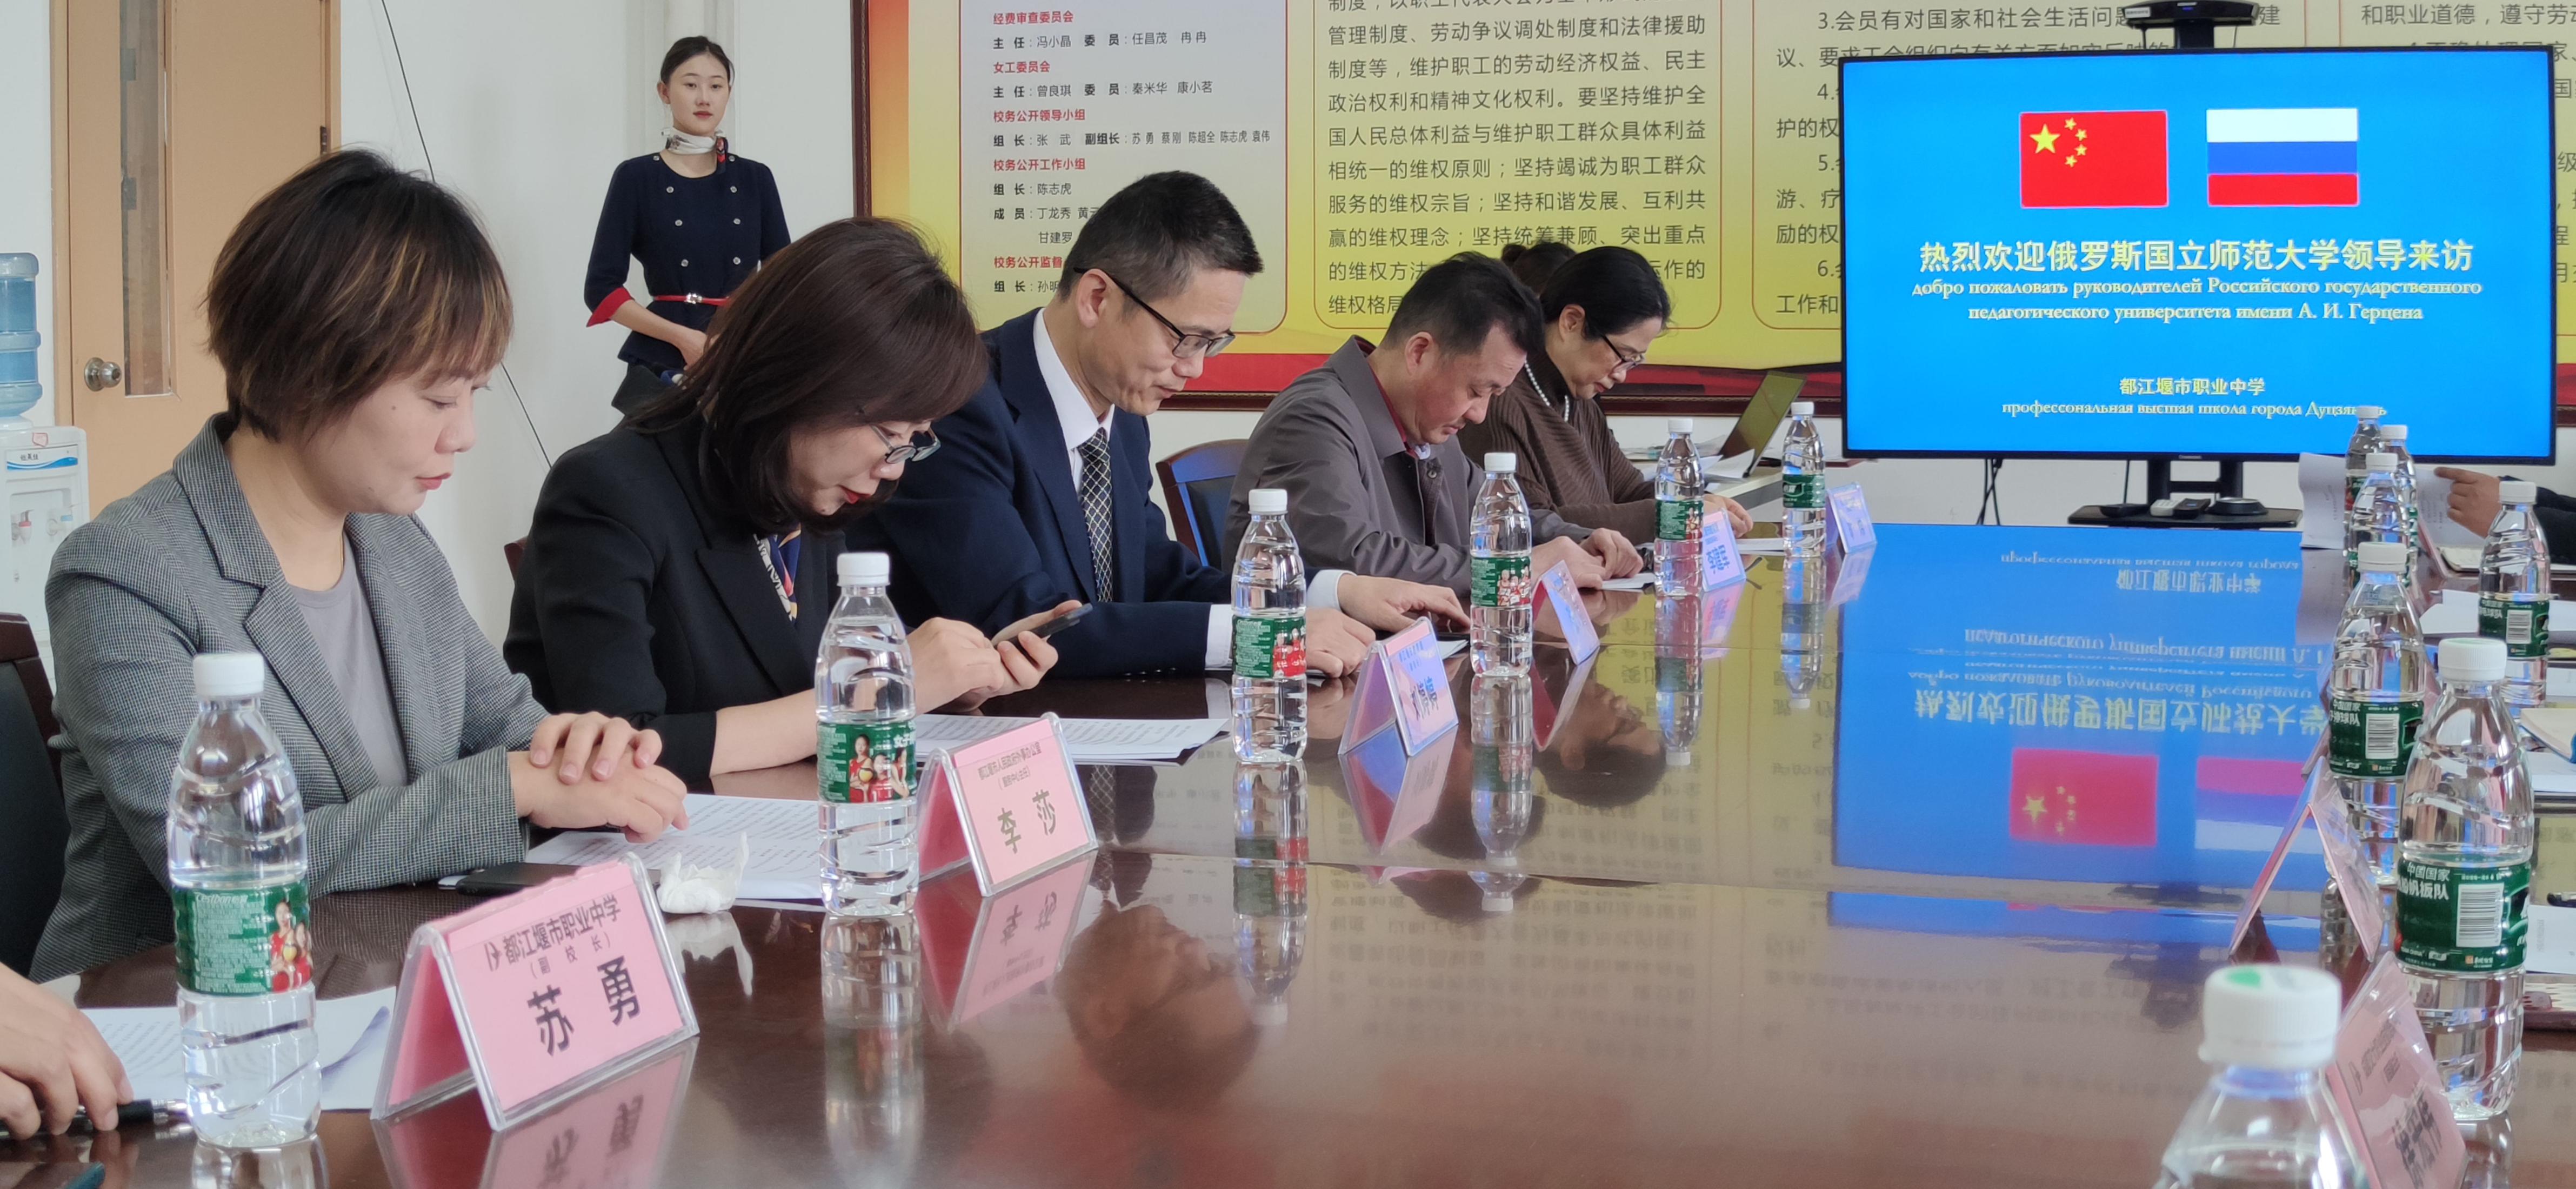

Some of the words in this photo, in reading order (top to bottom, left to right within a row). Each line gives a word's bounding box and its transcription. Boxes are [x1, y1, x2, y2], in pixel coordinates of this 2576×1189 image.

[993, 10, 1073, 24] 经费审查委员会
[2361, 4, 2576, 25] 和职业道德，遵守劳
[1329, 14, 1705, 45] 管理制度、劳动争议调处制度和法律援助
[993, 61, 1050, 74] 女工委员会
[1329, 50, 1706, 79] 制度等，维护职工的劳动经济权益、民主
[1328, 84, 1706, 113] 政治权利和精神文化权利。要坚持维护全
[993, 109, 1085, 122] 校务公开领导小组
[1329, 119, 1706, 147] 国人民总体利益与维护职工群众具体利益
[993, 158, 1086, 171] 校务公开工作小组
[1329, 155, 1706, 181] 相统一的维权原则；坚持竭诚为职工群众
[1329, 190, 1706, 214] 服务的维权宗旨；坚持和谐发展、互利共
[1038, 231, 1072, 244] 甘建罗
[994, 256, 1063, 268] 校务公开监督
[1919, 239, 2474, 272] 热烈欢迎俄罗斯国立师范大学领导来访
[1912, 279, 1964, 299] добро
[1968, 283, 2068, 294] пожаловать
[2073, 277, 2203, 298] руководителей
[2207, 277, 2320, 294] Российского
[2324, 281, 2482, 298] государственного
[1776, 294, 1838, 314] 工作和
[1968, 307, 2109, 320] педагогического
[2114, 307, 2231, 324] университета
[2235, 306, 2292, 318] имени
[2349, 303, 2424, 324] Герцена
[2119, 377, 2266, 396] 都江堰市职业中学
[2251, 405, 2303, 420] города
[997, 789, 1056, 854] 李莎
[2407, 861, 2451, 882] 中国国家
[503, 894, 622, 964] 都江堰市职业中学
[528, 955, 642, 1057] 苏勇
